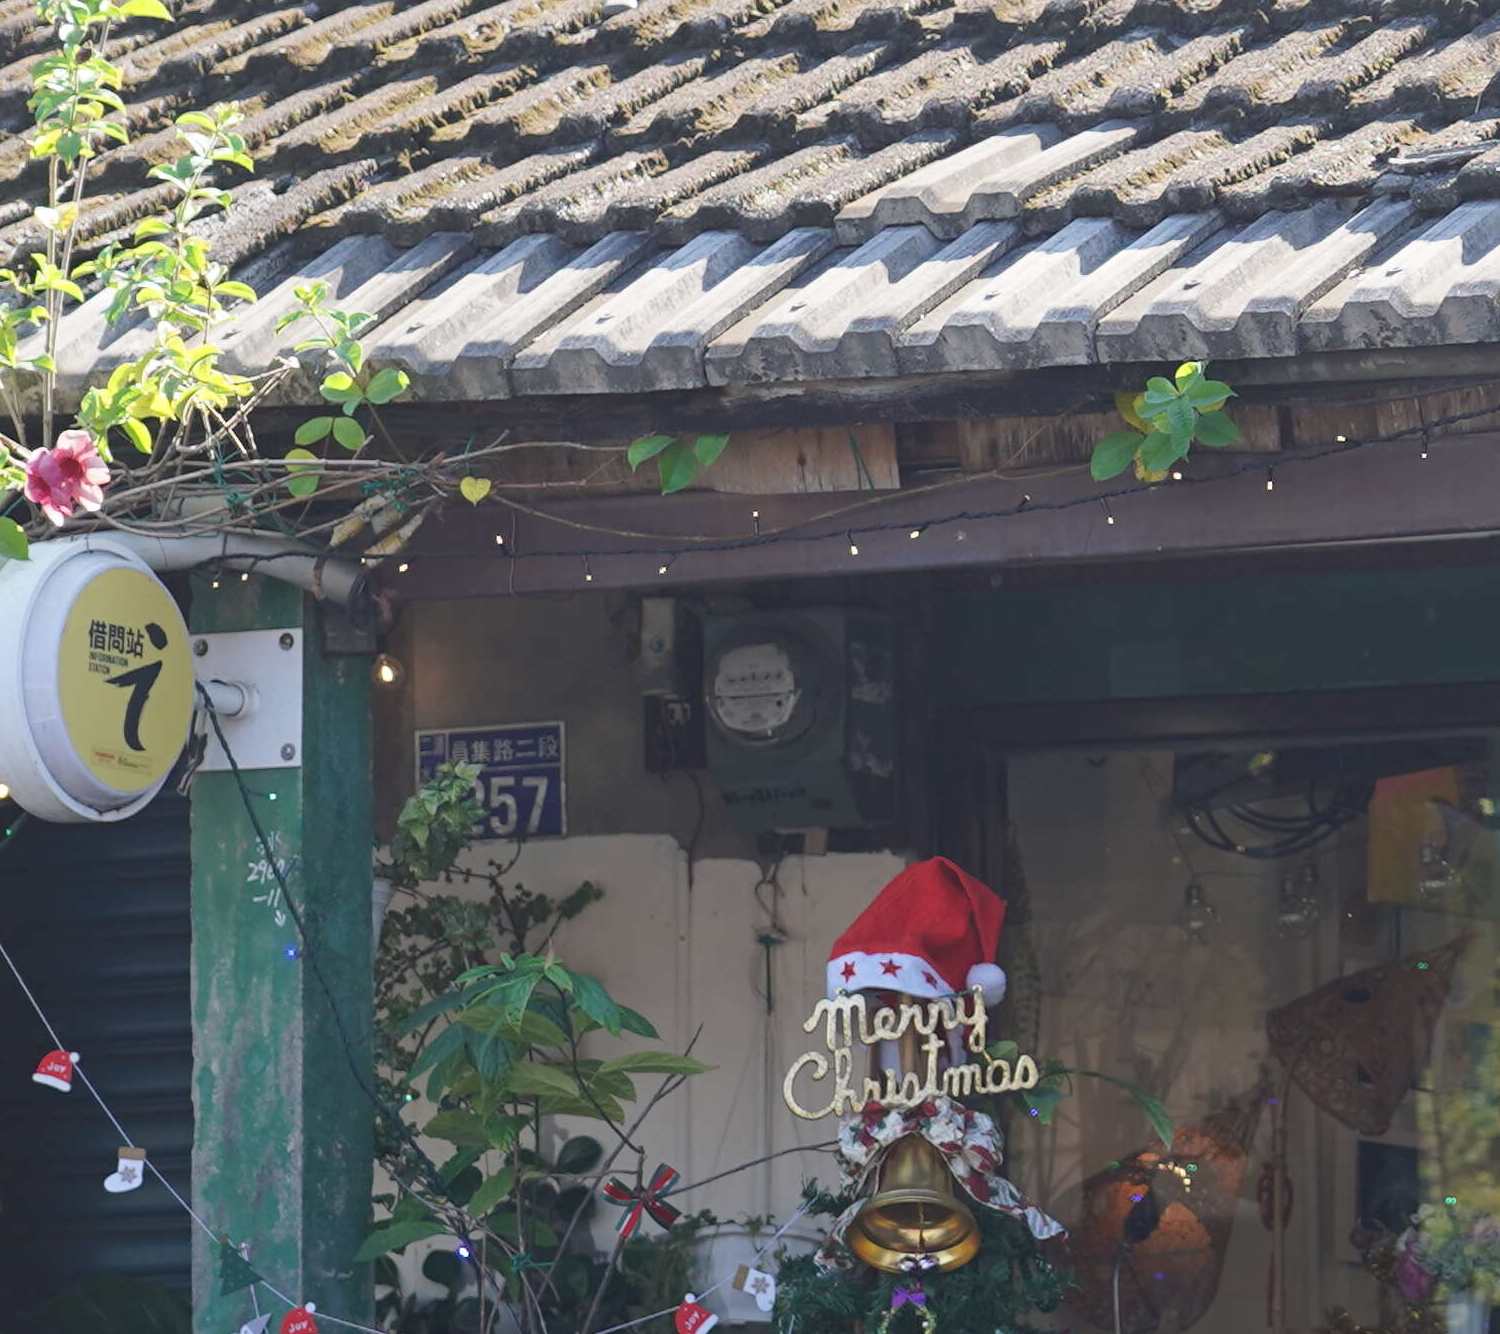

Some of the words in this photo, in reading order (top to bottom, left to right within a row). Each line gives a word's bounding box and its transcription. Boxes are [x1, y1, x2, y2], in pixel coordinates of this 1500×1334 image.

[88, 619, 145, 659] 借問站
[452, 735, 559, 762] 員集路二段
[803, 984, 988, 1053] Merry
[783, 1033, 1039, 1120] Christmas
